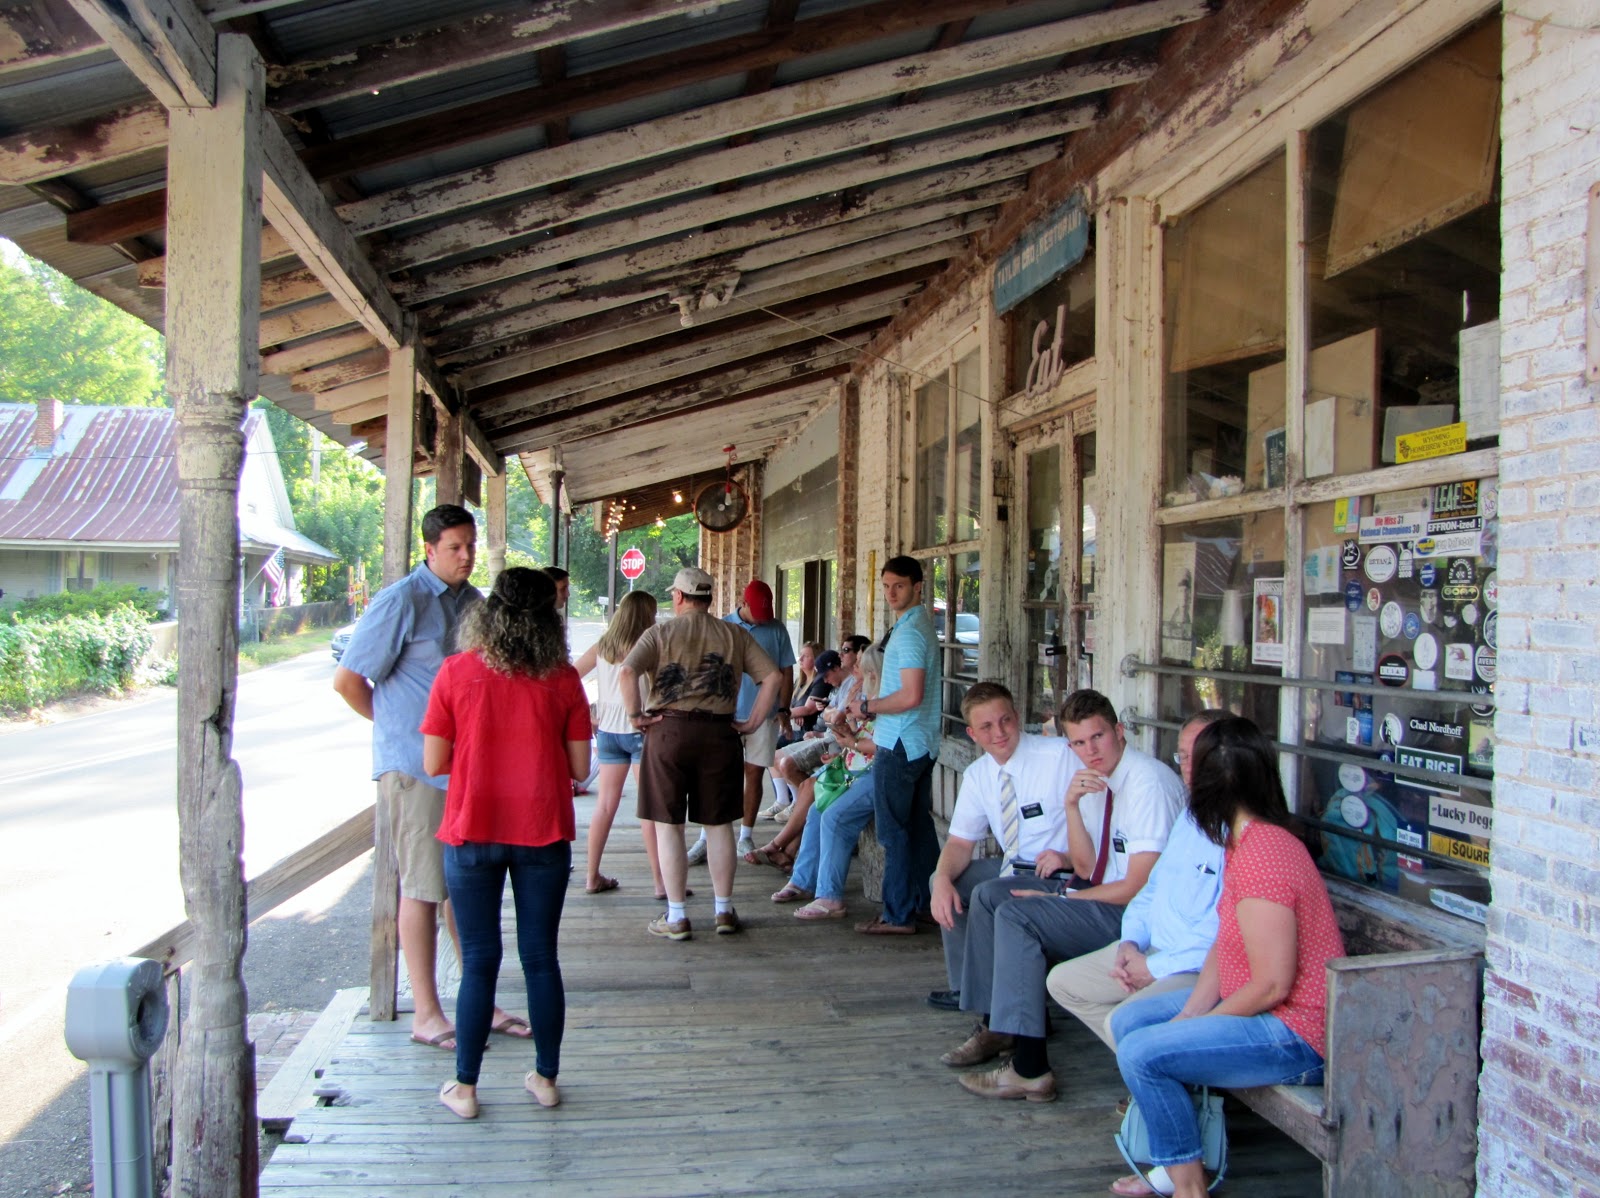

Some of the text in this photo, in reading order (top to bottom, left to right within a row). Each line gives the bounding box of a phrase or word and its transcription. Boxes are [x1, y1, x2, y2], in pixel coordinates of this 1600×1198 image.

[1422, 432, 1450, 444] WYOMING
[1410, 442, 1441, 455] HOMEBREW
[1443, 437, 1464, 448] SUPPLY
[1434, 483, 1461, 512] LEAF
[1375, 516, 1404, 527] Ole Miss 31
[1427, 519, 1475, 532] EFFRON-ized
[1360, 528, 1381, 537] National
[1382, 525, 1412, 536] Champions
[622, 558, 643, 570] STOP
[1410, 719, 1428, 732] Chad
[1428, 721, 1463, 737] Nordhoff
[1400, 754, 1456, 773] EAT RICE
